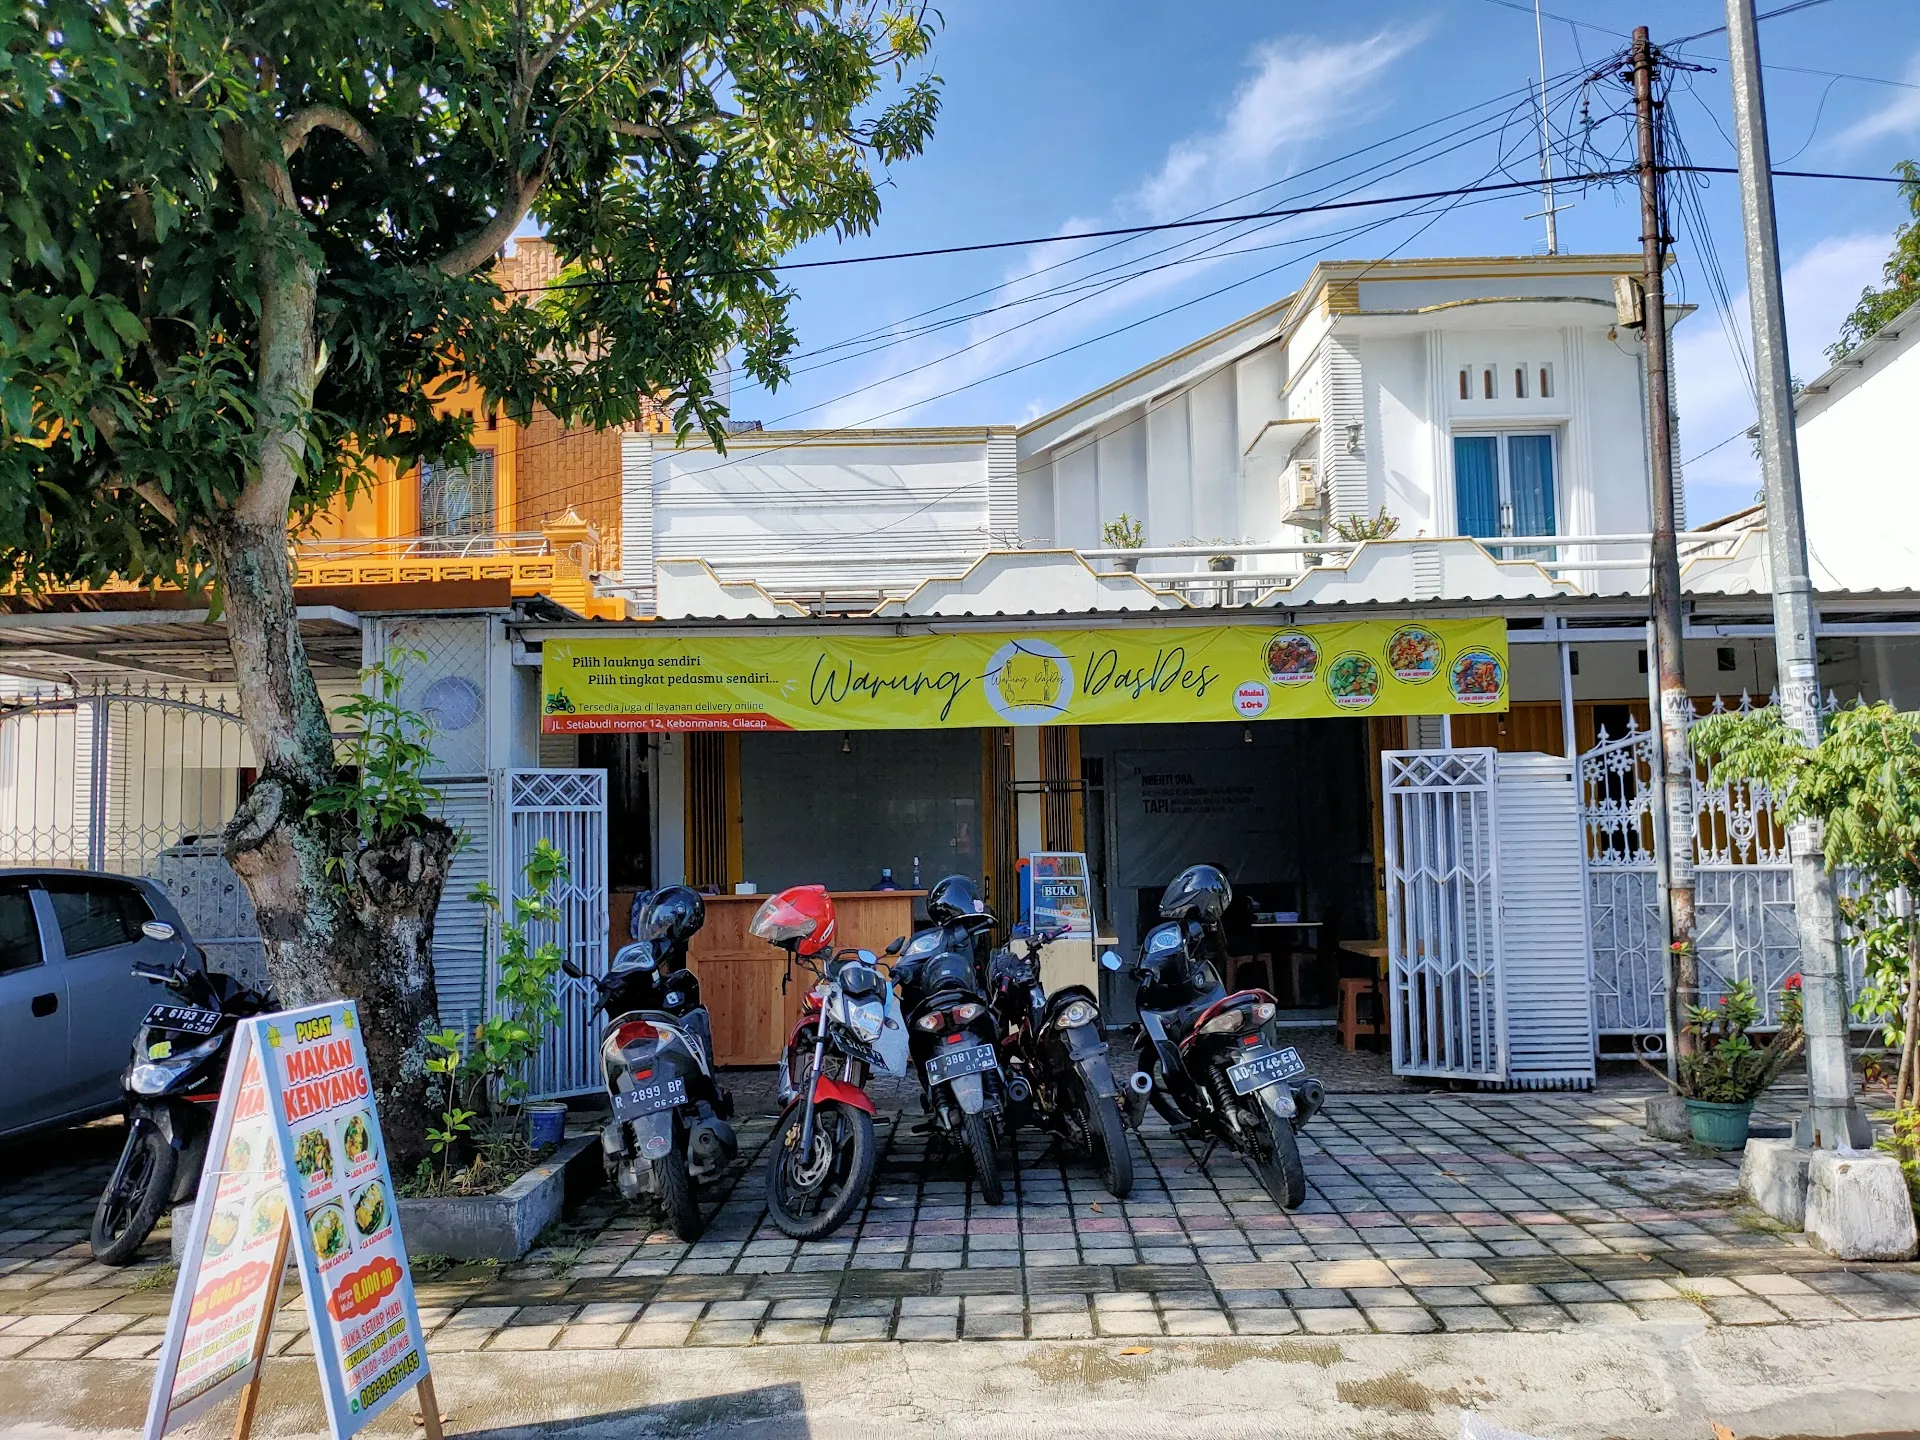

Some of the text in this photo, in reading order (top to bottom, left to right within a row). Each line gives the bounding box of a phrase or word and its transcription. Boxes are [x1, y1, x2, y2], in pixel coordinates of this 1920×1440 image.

[572, 655, 701, 669] Pilih lauknya sendiri
[588, 672, 779, 687] Pilih tingkat pedasmu sendiri...
[1083, 647, 1220, 699] DasDes
[810, 653, 972, 722] Warung
[1238, 688, 1264, 698] Mulai
[578, 701, 764, 713] Tersedia juga di layanan delivery online
[1240, 701, 1263, 709] 10rb
[551, 718, 767, 731] JL. Setiabudi nomor 12, Kebonmanis, Cilacap
[1142, 799, 1169, 814] TAPI
[1044, 886, 1077, 896] BUKA
[154, 1007, 164, 1016] R
[168, 1008, 198, 1020] 6193
[295, 1015, 332, 1044] PUSAT
[285, 1038, 353, 1084] MAKAN
[930, 1045, 993, 1072] H 3881 CJ
[1233, 1066, 1250, 1082] AD
[1249, 1056, 1281, 1075] 2746
[282, 1066, 369, 1123] KENYANG
[615, 1080, 682, 1109] R 2899 BP
[354, 1151, 368, 1163] AYAM
[310, 1171, 325, 1183] AYAM
[352, 1266, 394, 1304] 8.000 an
[341, 1300, 403, 1352] BUKA SETIAP HARI
[370, 1330, 388, 1354] RABU
[387, 1318, 407, 1340] TUTUP
